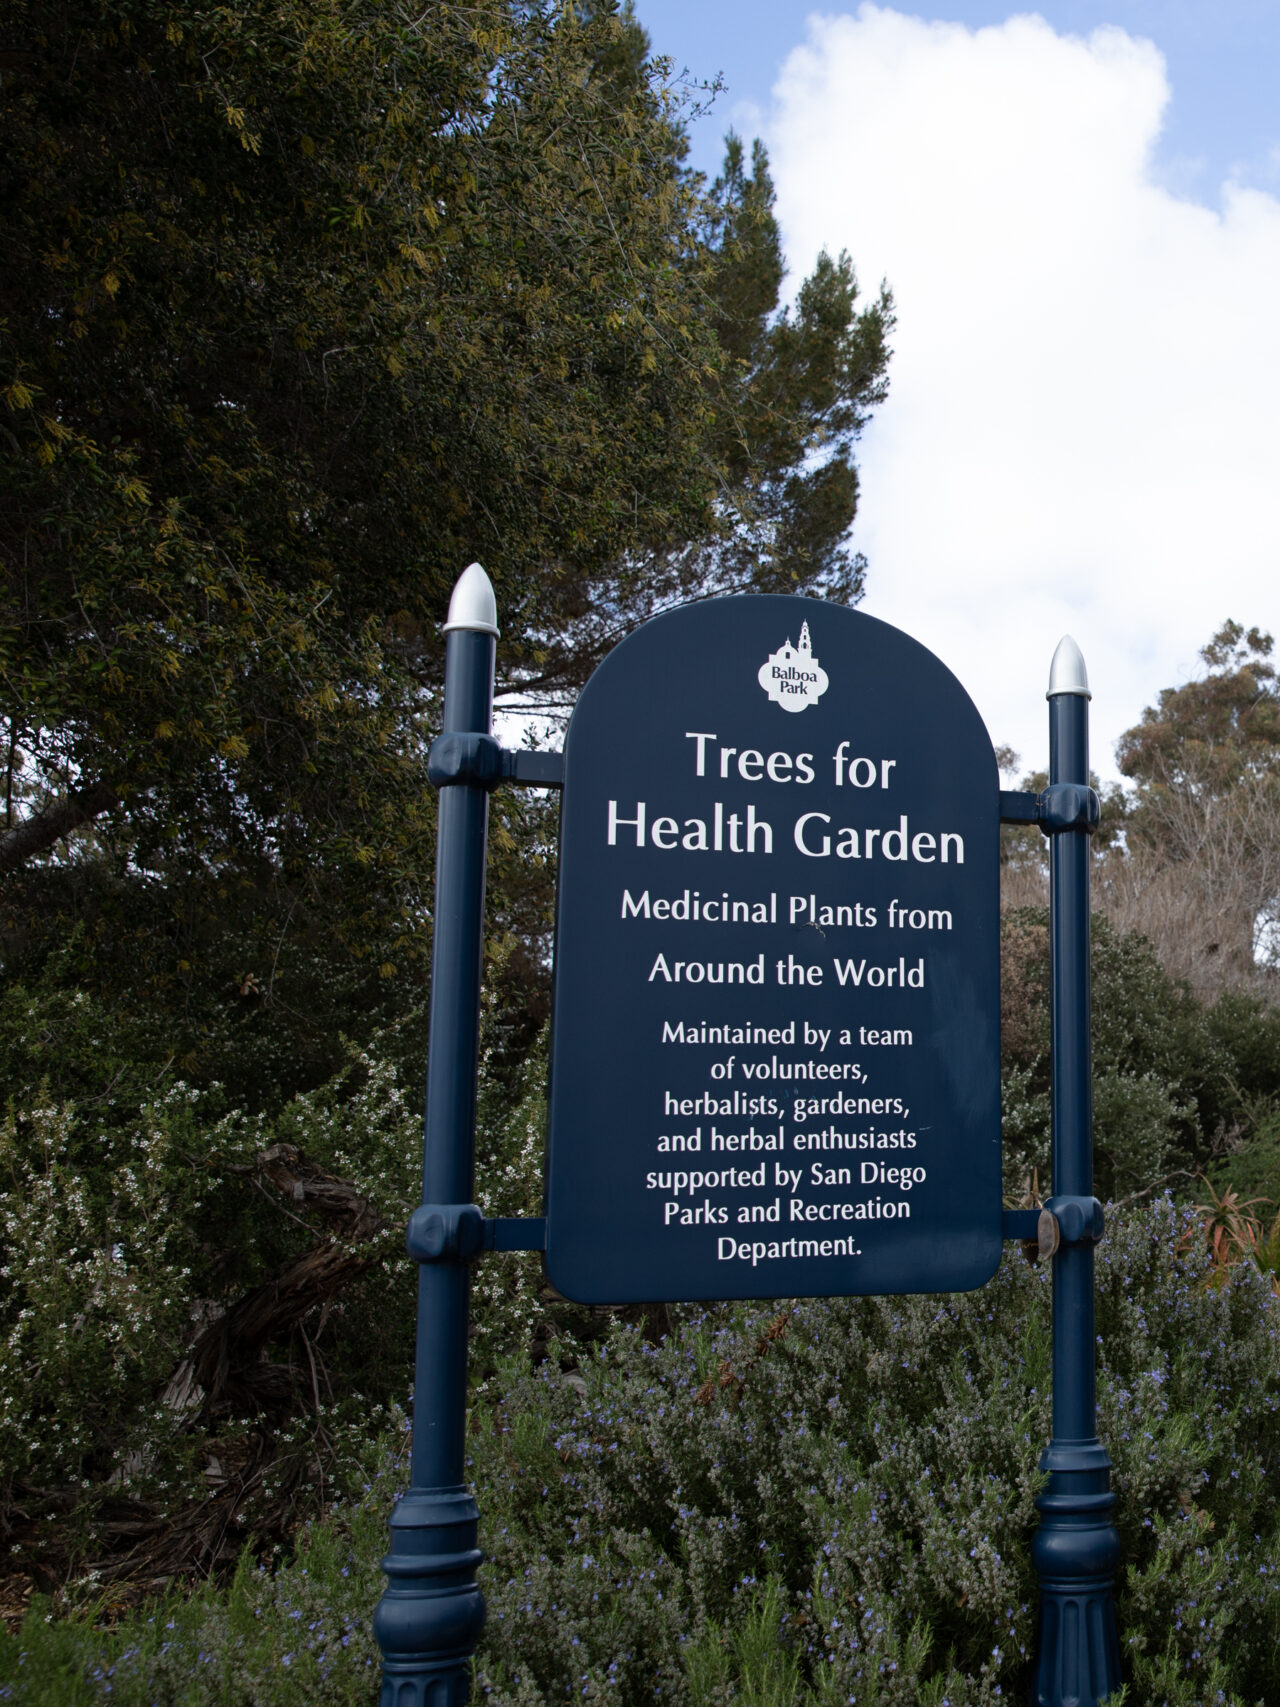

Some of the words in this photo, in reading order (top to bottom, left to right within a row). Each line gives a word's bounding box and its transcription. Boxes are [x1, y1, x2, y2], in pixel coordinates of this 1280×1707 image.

[772, 666, 817, 682] Balboa
[780, 681, 808, 695] Park
[686, 733, 815, 784] Trees
[833, 741, 896, 789] for
[608, 800, 772, 853] Health
[794, 813, 963, 863] Garden
[621, 889, 776, 924] Medicinal
[790, 895, 877, 927] Plants
[888, 899, 952, 930] from
[648, 952, 764, 985] Around
[776, 954, 823, 985] the
[834, 958, 924, 987] World
[662, 1021, 794, 1045] Maintained
[805, 1022, 831, 1051] by
[839, 1029, 851, 1044] a
[860, 1027, 912, 1045] team
[711, 1056, 735, 1080] of
[742, 1056, 867, 1084] volunteers,
[665, 1091, 784, 1120] herbalists,
[794, 1091, 909, 1122] gardeners,
[657, 1127, 701, 1152] and
[712, 1126, 783, 1151] herbal
[794, 1126, 916, 1150] enthusiasts
[647, 1163, 765, 1195] supported
[775, 1163, 802, 1193] by
[811, 1163, 850, 1185] San
[861, 1162, 926, 1190] Diego
[665, 1199, 728, 1225] Parks
[738, 1198, 779, 1223] and
[790, 1197, 909, 1221] Recreation
[718, 1236, 861, 1266] Department.
